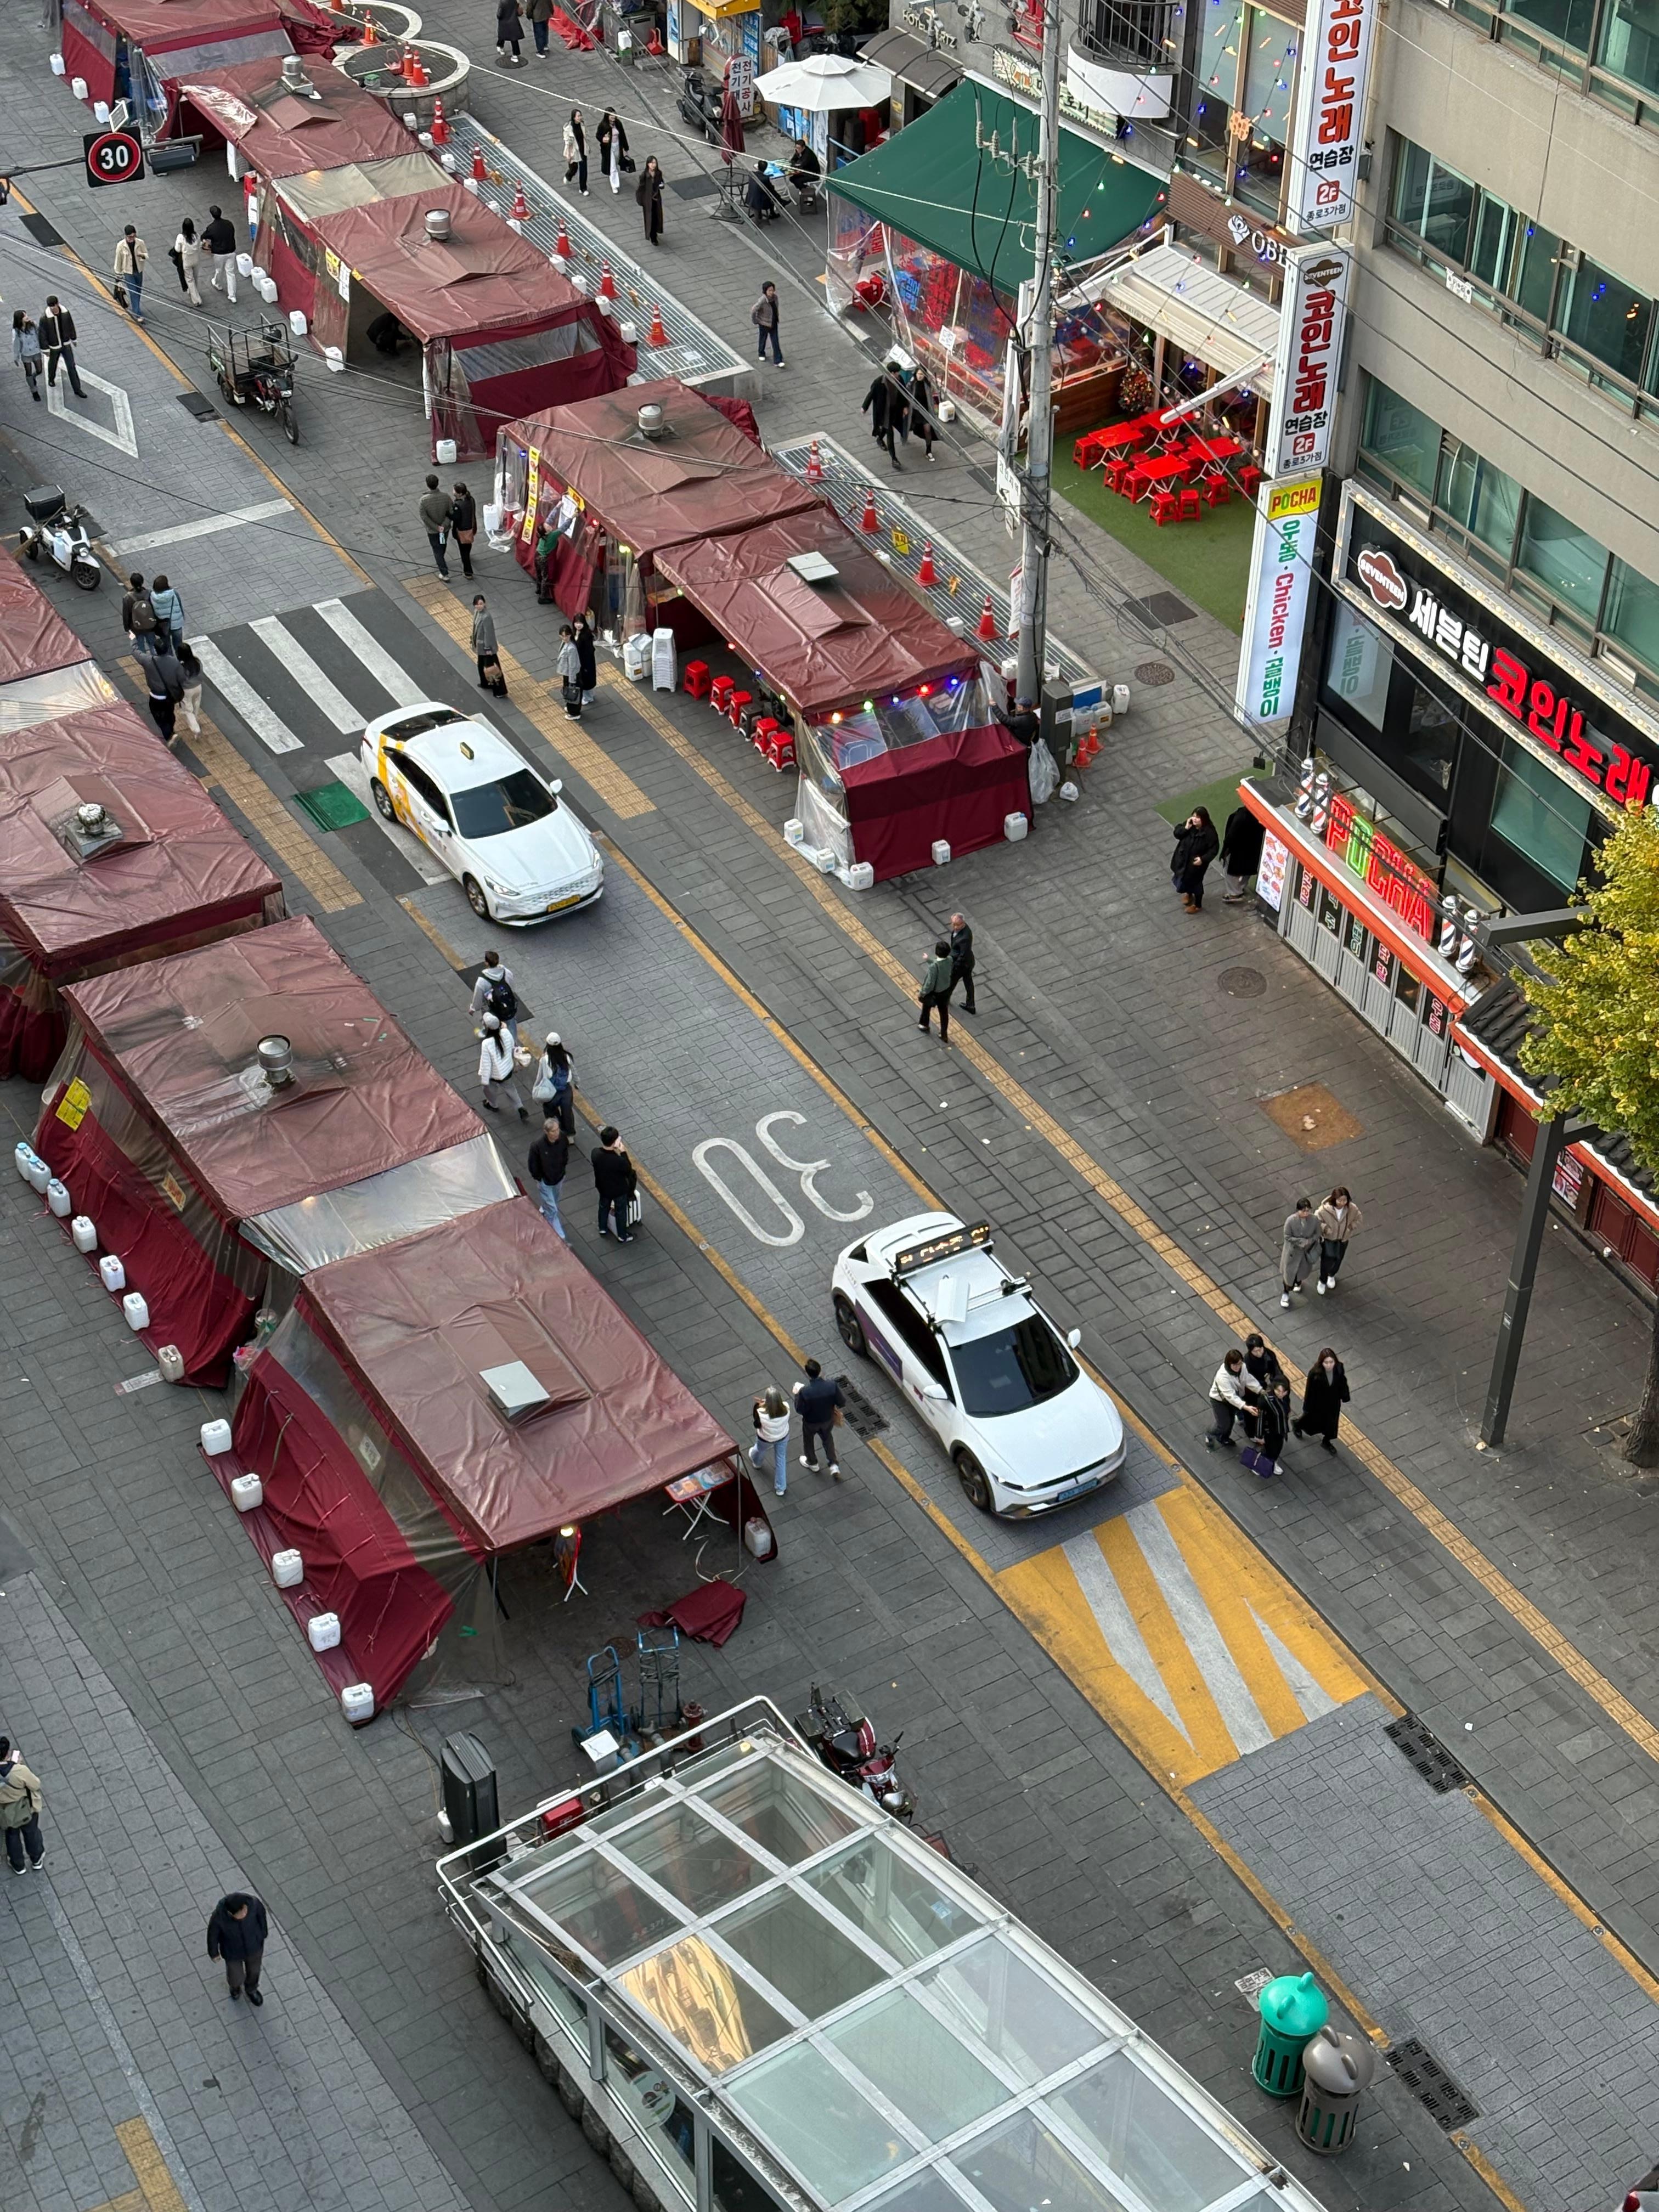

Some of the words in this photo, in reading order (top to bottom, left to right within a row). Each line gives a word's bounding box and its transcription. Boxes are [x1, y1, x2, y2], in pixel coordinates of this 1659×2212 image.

[741, 59, 752, 112] 전기공사
[100, 145, 128, 170] 30
[1309, 145, 1354, 172] 연습장
[1318, 184, 1338, 203] 2F
[1306, 203, 1346, 222] 종로3가점
[1304, 266, 1344, 280] SEVENTEEN
[1293, 290, 1336, 416] 코인노래
[1285, 411, 1328, 437] 연습장
[1283, 451, 1322, 469] 종로3가점
[1295, 437, 1313, 454] 2F
[1271, 486, 1317, 512] POCHA
[1278, 519, 1306, 563] 우동
[1359, 558, 1404, 602] SEVENTEEN
[1268, 572, 1295, 649] Chicken
[1260, 657, 1284, 718] 골뱅이
[1409, 591, 1489, 682] 세븐틴
[1487, 646, 1651, 813] 코인노래
[1326, 795, 1429, 941] POCHA
[692, 1110, 874, 1246] 30
